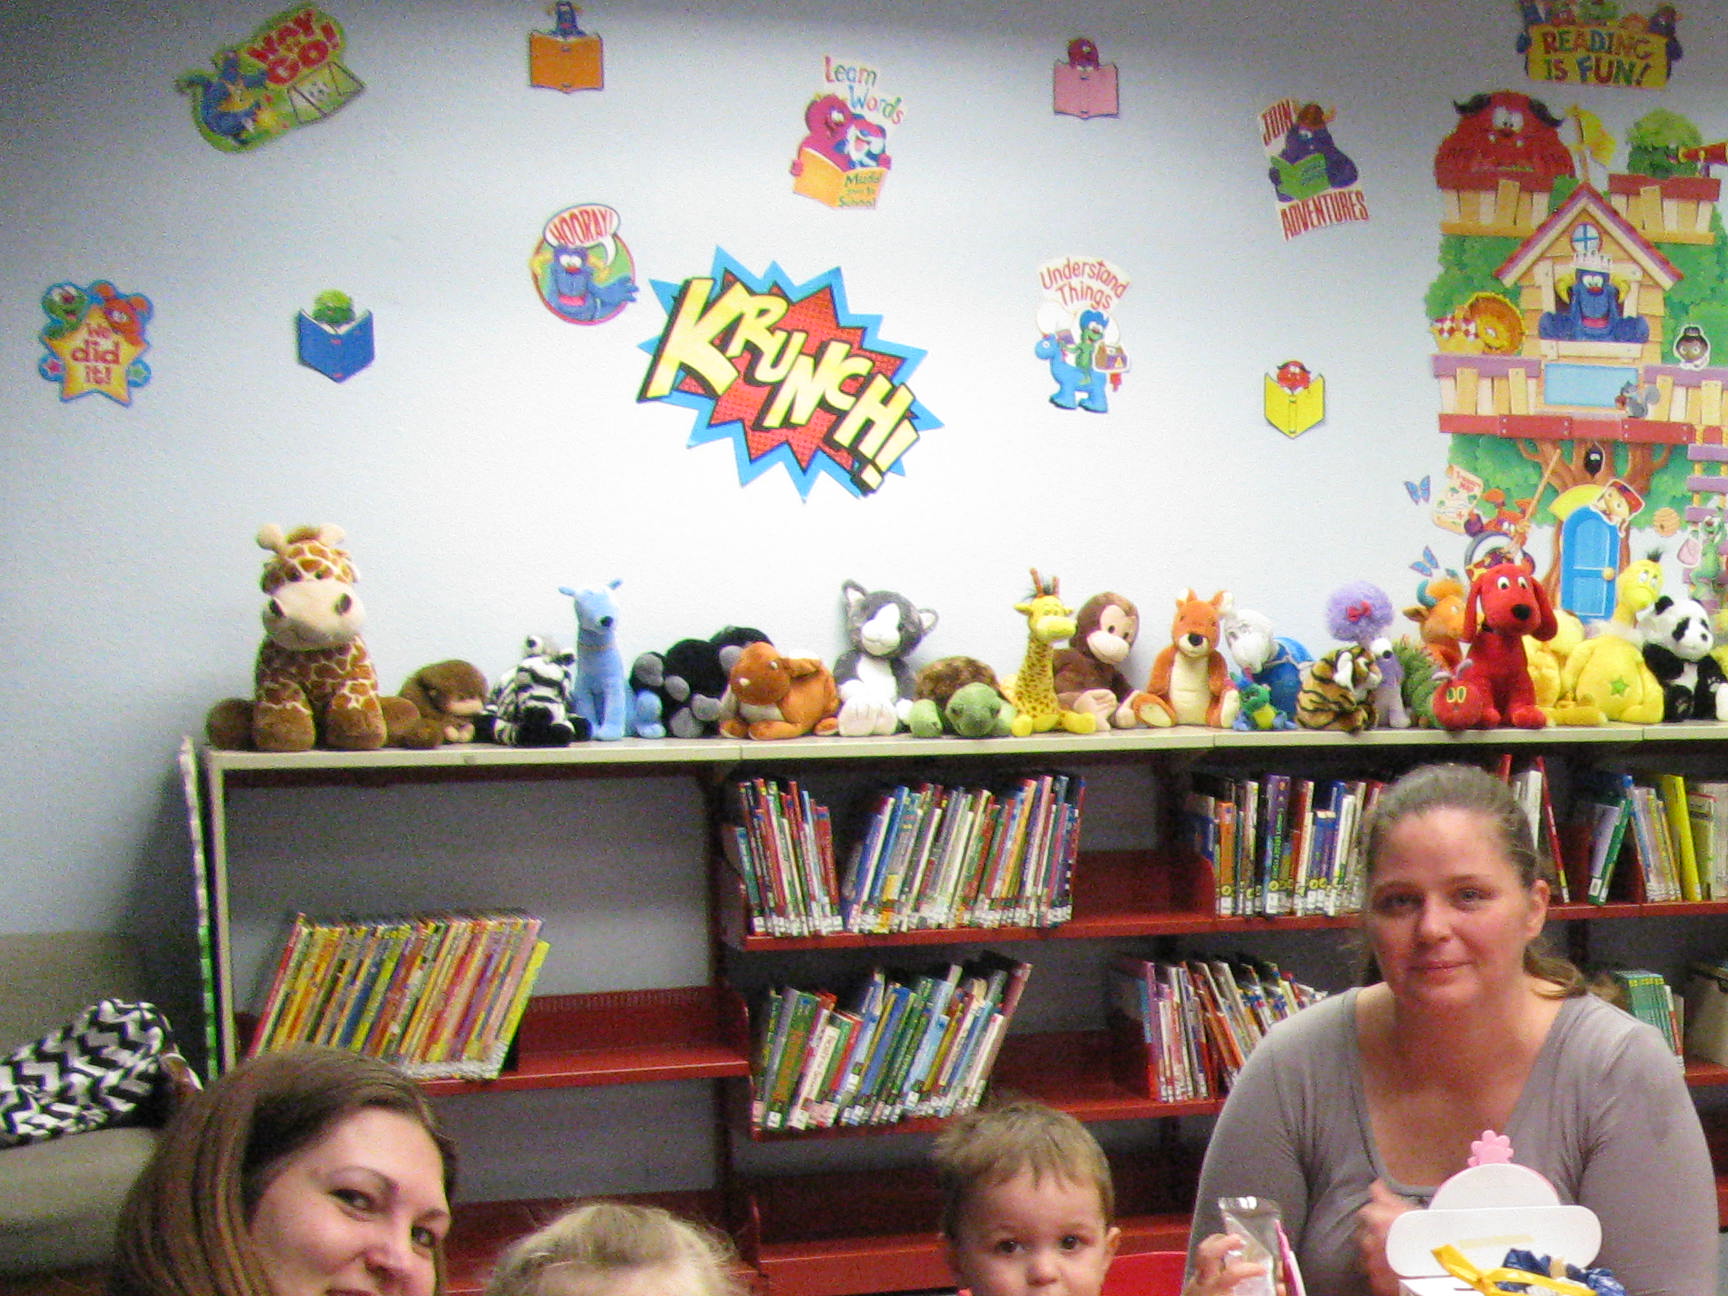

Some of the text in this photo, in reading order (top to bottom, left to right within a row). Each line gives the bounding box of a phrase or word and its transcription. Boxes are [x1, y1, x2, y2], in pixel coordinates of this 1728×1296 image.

[265, 23, 342, 86] GO!
[1542, 29, 1653, 60] READING
[824, 55, 877, 87] Learn
[1543, 56, 1652, 86] IS FUN!
[848, 84, 904, 125] Words
[1263, 99, 1295, 147] JOIN
[1280, 189, 1370, 242] ADVENTURES
[1040, 257, 1131, 298] Understand
[1055, 281, 1113, 311] Things
[637, 277, 920, 497] KRUNCH!
